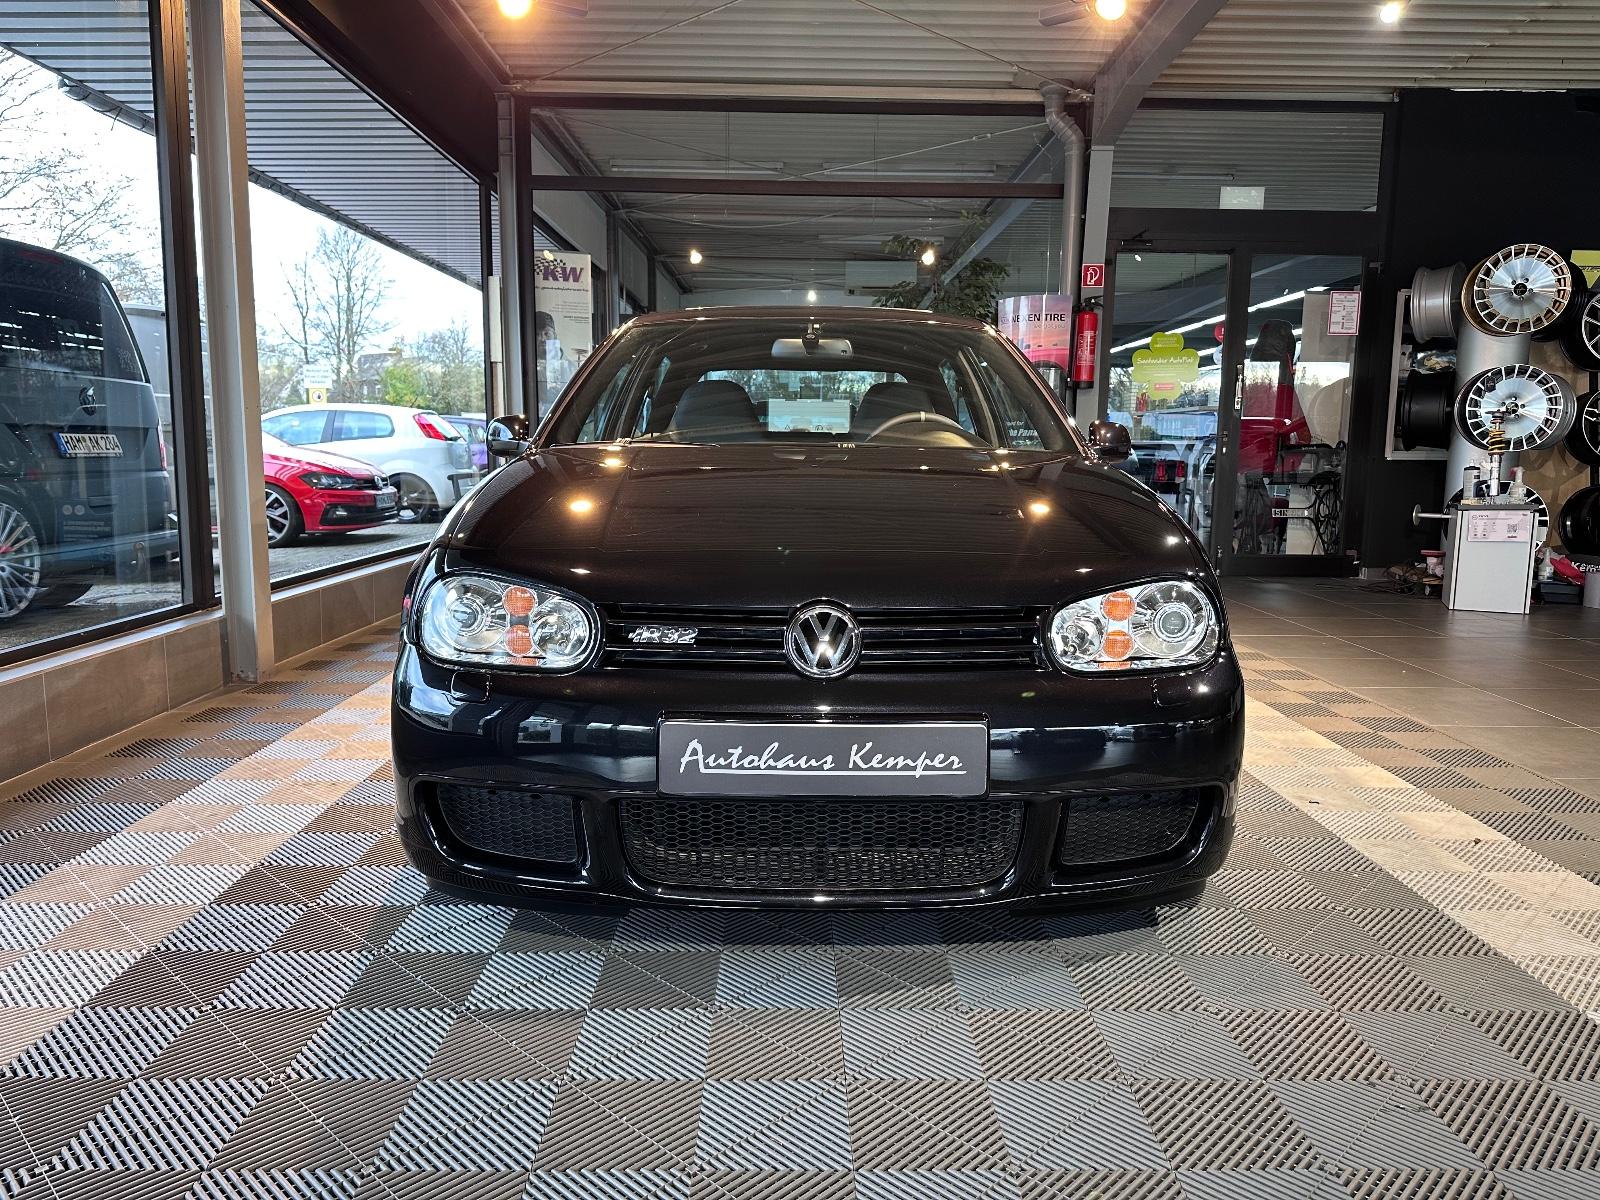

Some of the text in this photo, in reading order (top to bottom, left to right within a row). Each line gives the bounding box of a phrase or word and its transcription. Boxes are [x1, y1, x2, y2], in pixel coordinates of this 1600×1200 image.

[542, 265, 584, 283] KW
[1044, 313, 1066, 322] TIRE
[1136, 356, 1168, 365] Santander
[61, 435, 85, 451] HAM
[88, 435, 104, 451] AK
[679, 738, 963, 778] Autohaus Kemper
